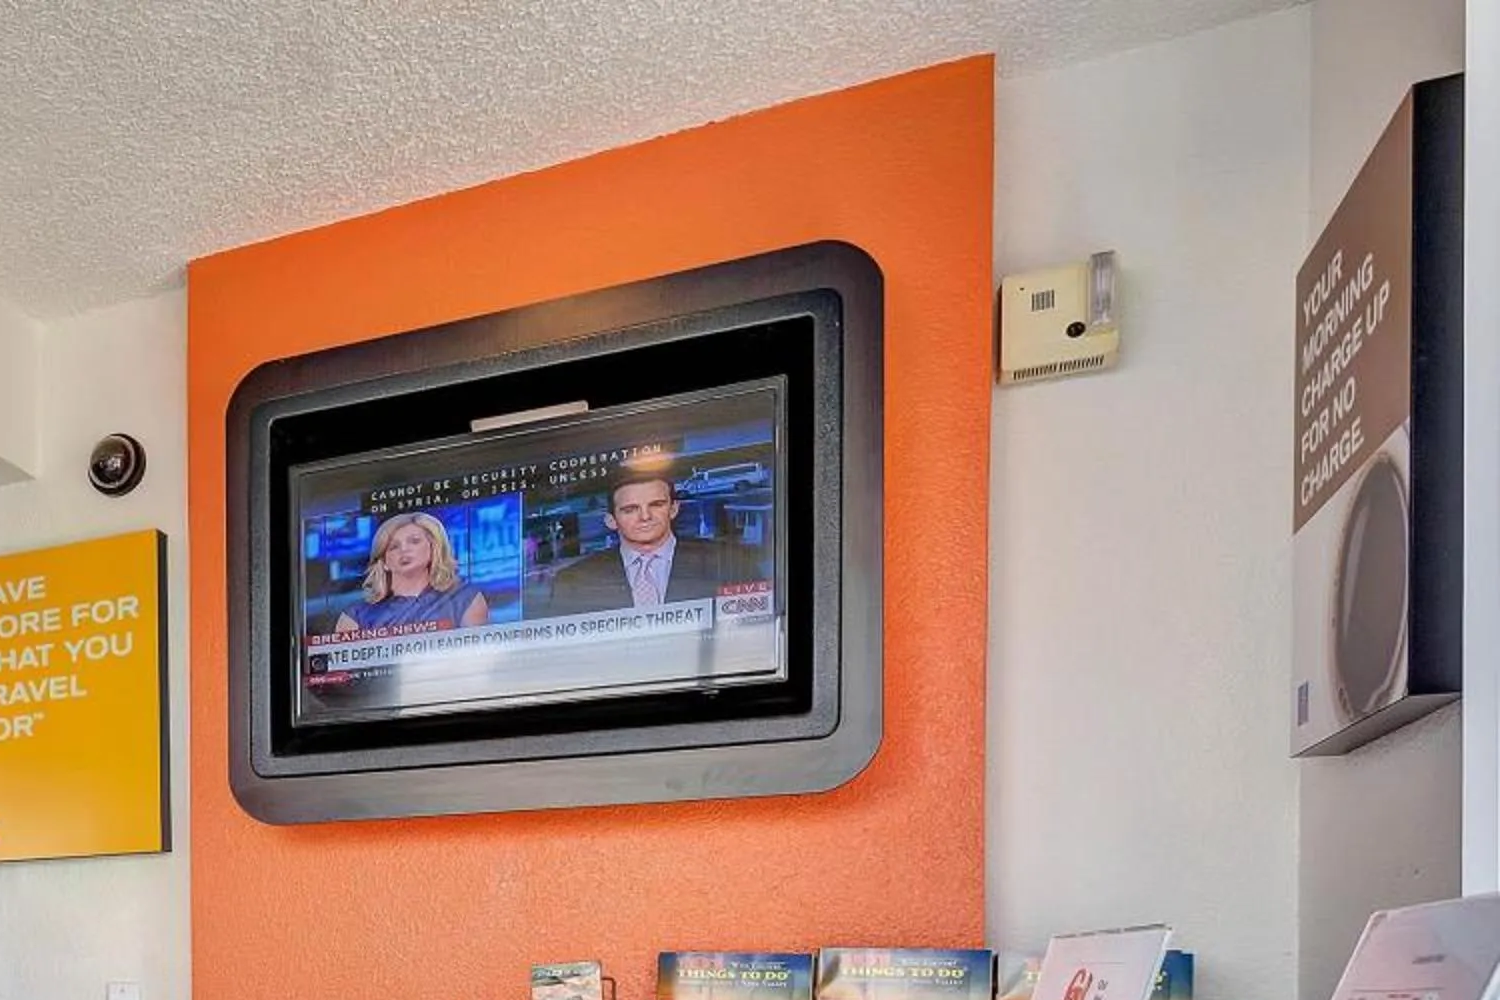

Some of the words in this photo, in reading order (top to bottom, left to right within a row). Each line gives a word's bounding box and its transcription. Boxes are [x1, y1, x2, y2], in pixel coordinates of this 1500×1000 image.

[1303, 250, 1343, 327] YOUR
[1301, 253, 1373, 375] MORNING
[1301, 317, 1362, 418] CHARGE
[1366, 279, 1390, 335] UP
[1301, 411, 1329, 465] FOR
[1332, 376, 1356, 422] NO
[371, 484, 422, 500] CANNOT
[433, 480, 450, 491] BE
[463, 466, 536, 485] SECURITY
[549, 444, 660, 471] COOPERATION
[1301, 416, 1364, 507] CHARGE
[462, 488, 479, 499] ON
[549, 467, 607, 484] UNLESS
[722, 595, 768, 614] CNN
[724, 582, 768, 596] LIVE
[71, 595, 140, 627] FOR
[556, 623, 576, 637] NO
[581, 613, 643, 633] SPECIFIC
[646, 607, 704, 626] THREAT
[64, 631, 133, 663] YOU
[311, 627, 388, 645] BREAKING
[393, 621, 437, 636] NEWS
[679, 968, 736, 980] THINGS
[740, 969, 761, 980] TO
[765, 970, 789, 981] DO
[842, 966, 905, 978] THINGS
[909, 967, 934, 977] TO
[938, 967, 965, 979] DO
